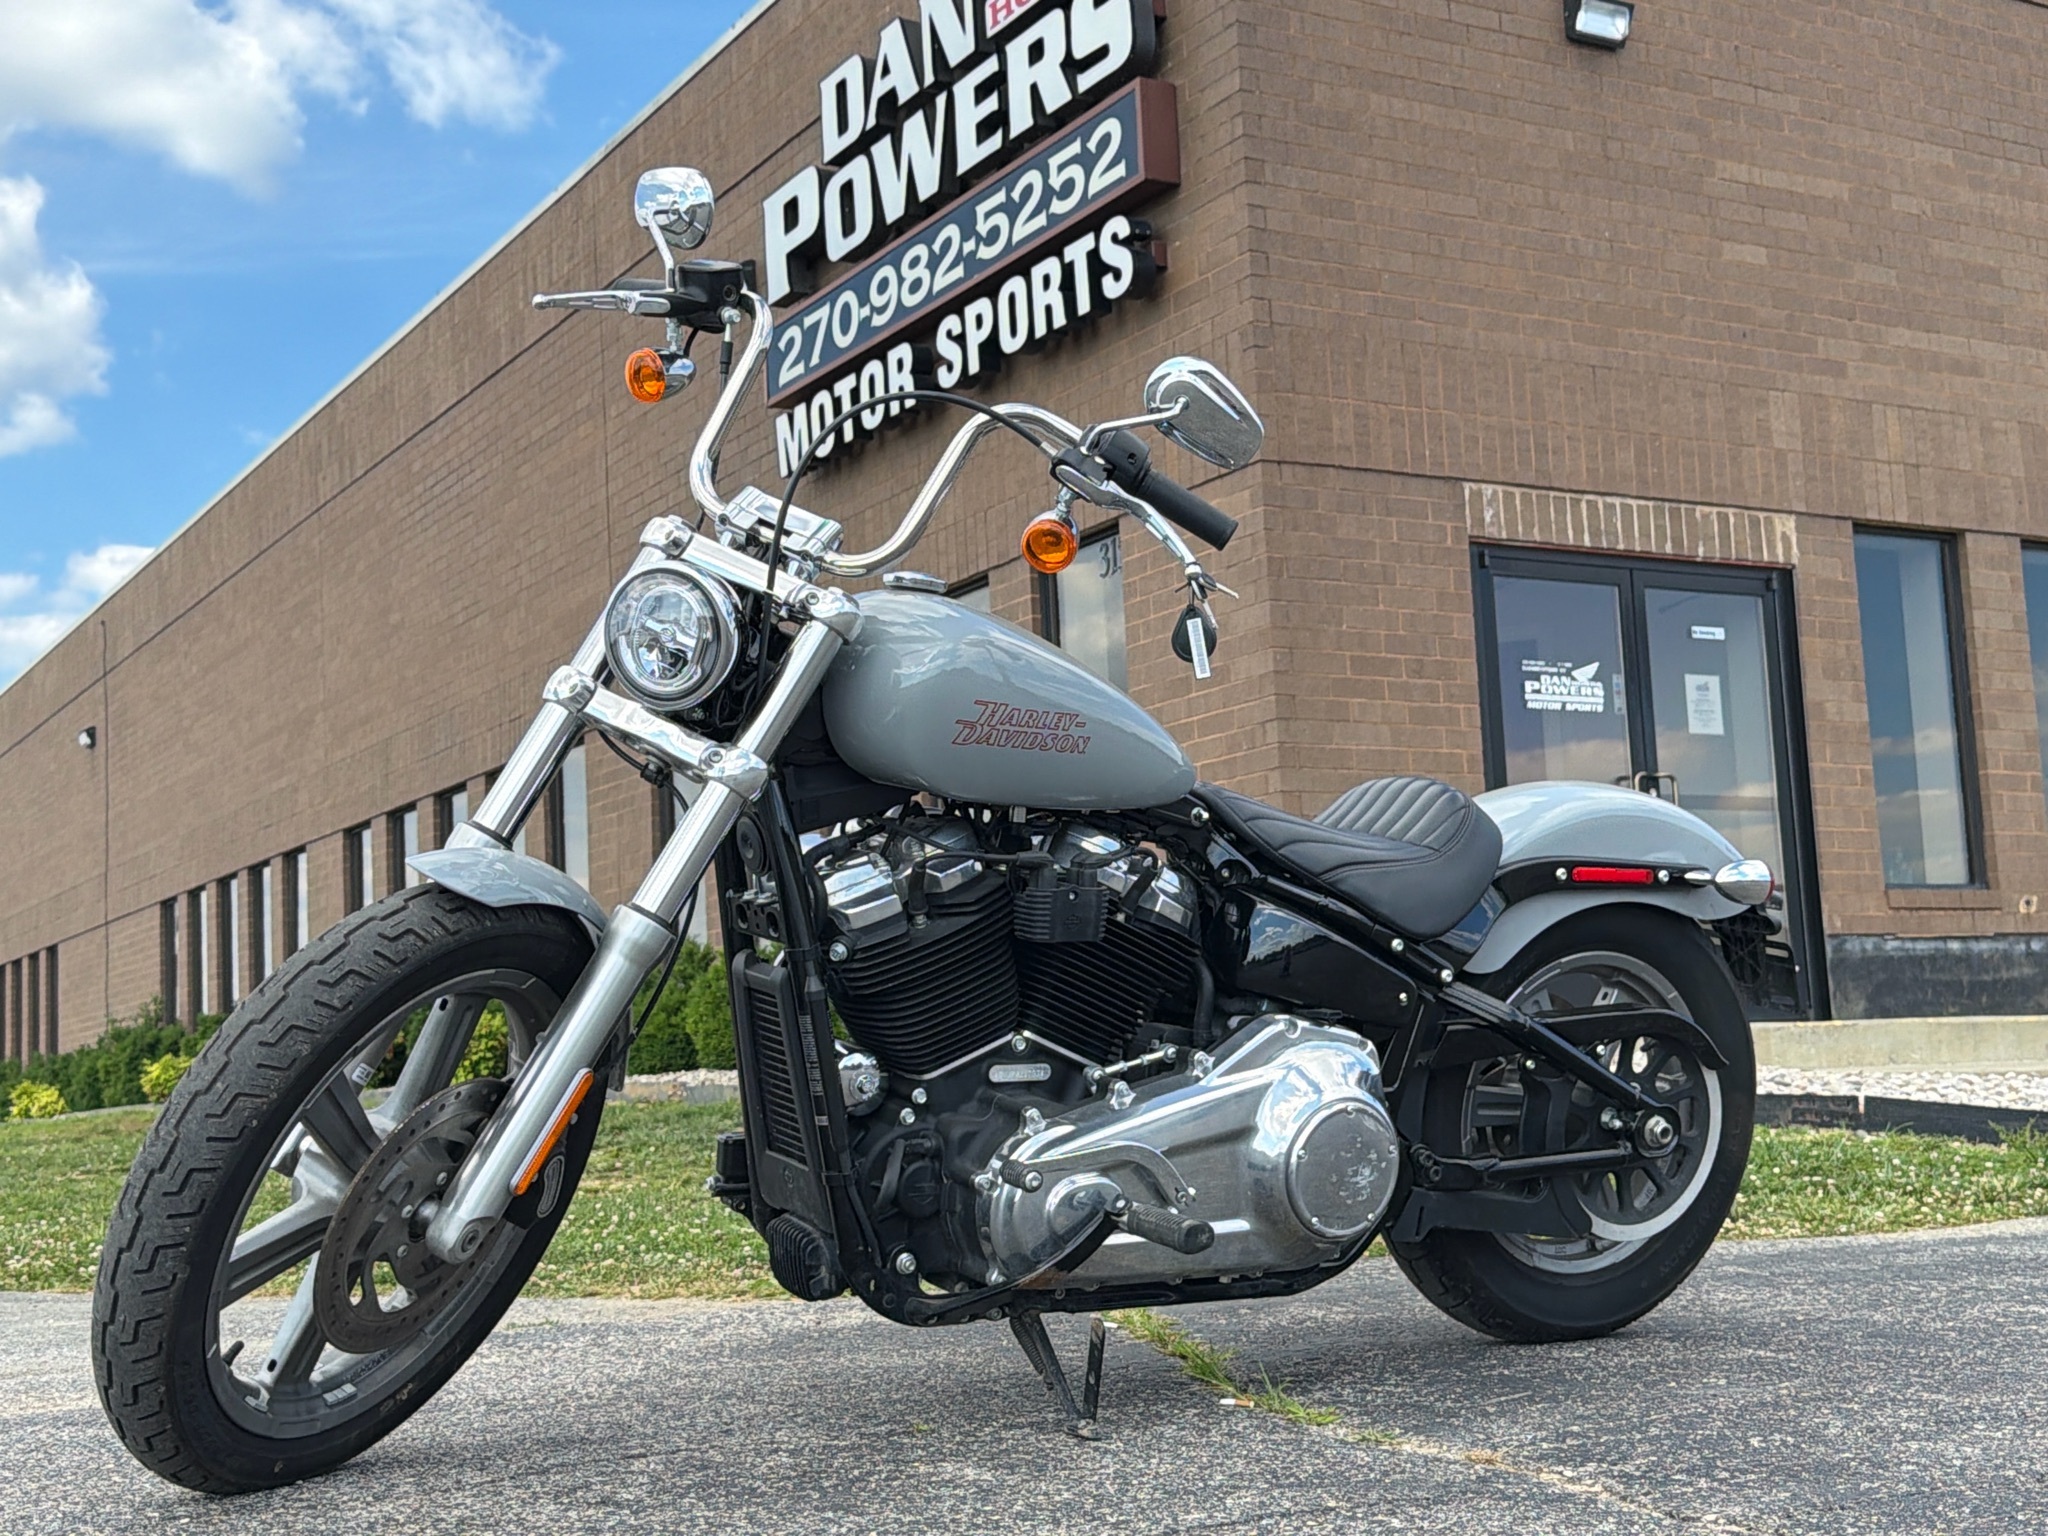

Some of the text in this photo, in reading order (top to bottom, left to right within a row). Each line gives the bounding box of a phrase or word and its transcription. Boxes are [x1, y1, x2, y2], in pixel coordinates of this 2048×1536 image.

[820, 0, 977, 164] DAN
[763, 0, 1133, 306] POWERS
[778, 117, 1127, 389] 270-982-5252
[775, 215, 1135, 479] MOTOR SPORTS
[1524, 680, 1605, 698] POWERS
[1540, 674, 1572, 687] DAN
[973, 699, 1086, 732] HARLEY-
[1526, 701, 1563, 711] MOTOR
[951, 719, 1091, 754] DAVIDSON
